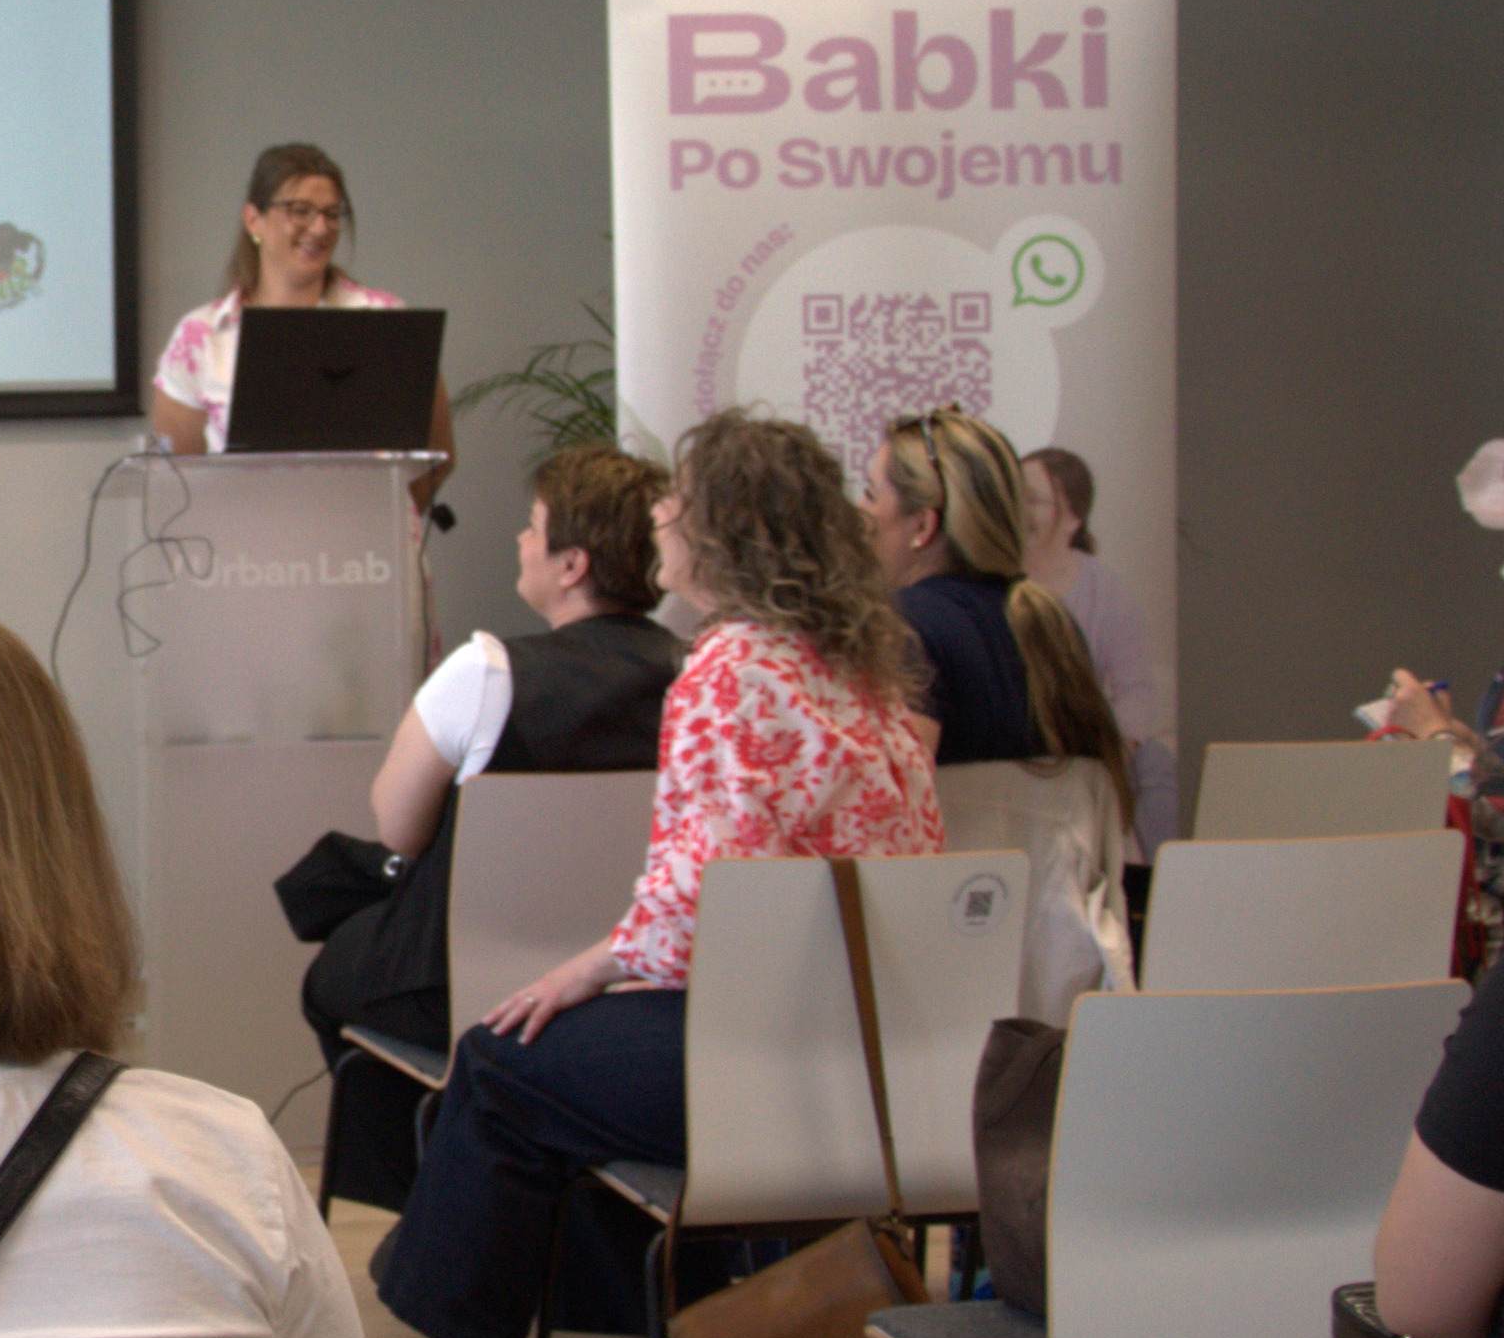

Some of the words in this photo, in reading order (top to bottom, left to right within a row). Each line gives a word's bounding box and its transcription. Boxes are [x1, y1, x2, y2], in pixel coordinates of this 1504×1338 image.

[667, 6, 1109, 115] Babki
[668, 138, 762, 191] Po
[777, 130, 1124, 201] Swojemu
[715, 274, 746, 311] do
[318, 550, 392, 586] Lab
